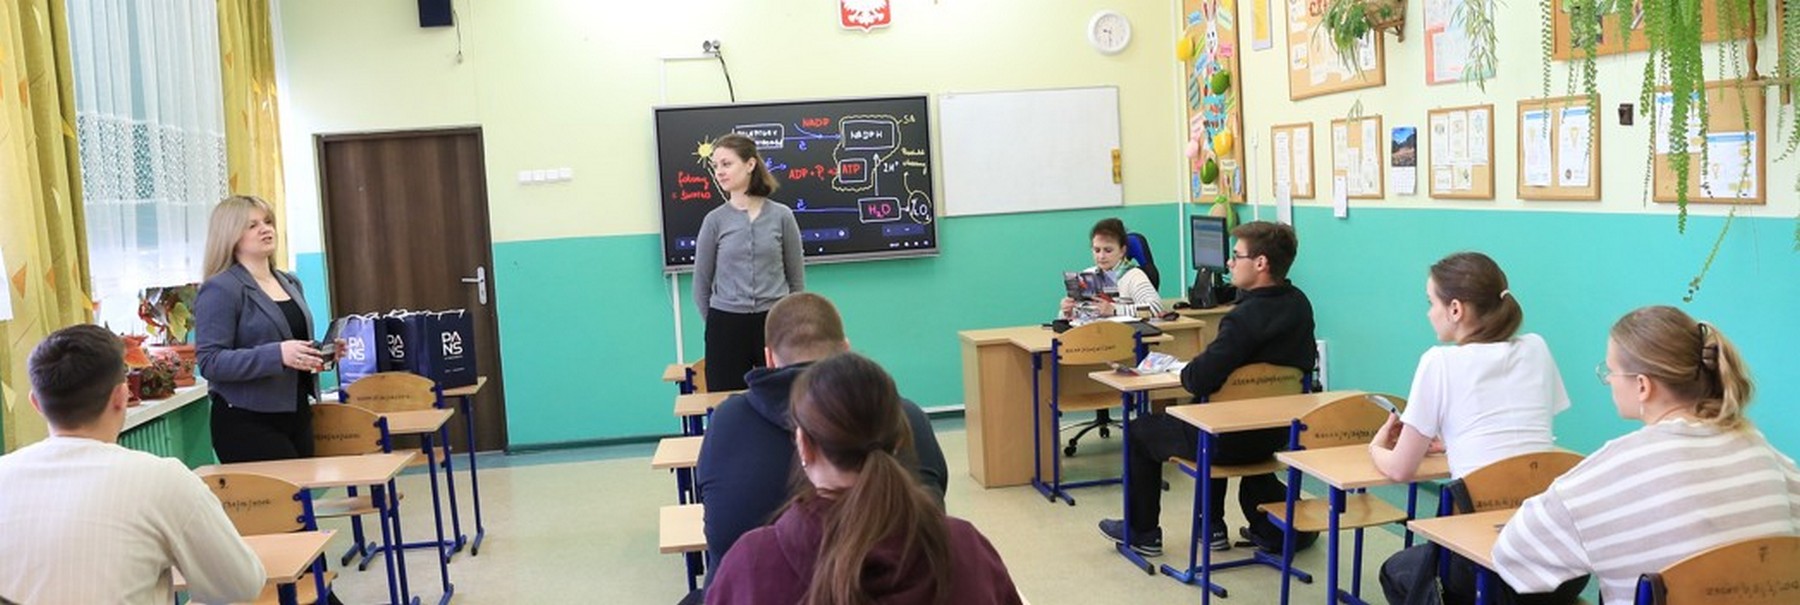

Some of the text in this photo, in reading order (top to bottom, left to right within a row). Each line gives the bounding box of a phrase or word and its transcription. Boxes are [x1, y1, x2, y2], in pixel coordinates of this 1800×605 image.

[850, 130, 883, 140] NADPH
[842, 163, 861, 175] ATP
[441, 331, 462, 343] PA
[442, 341, 464, 357] NS
